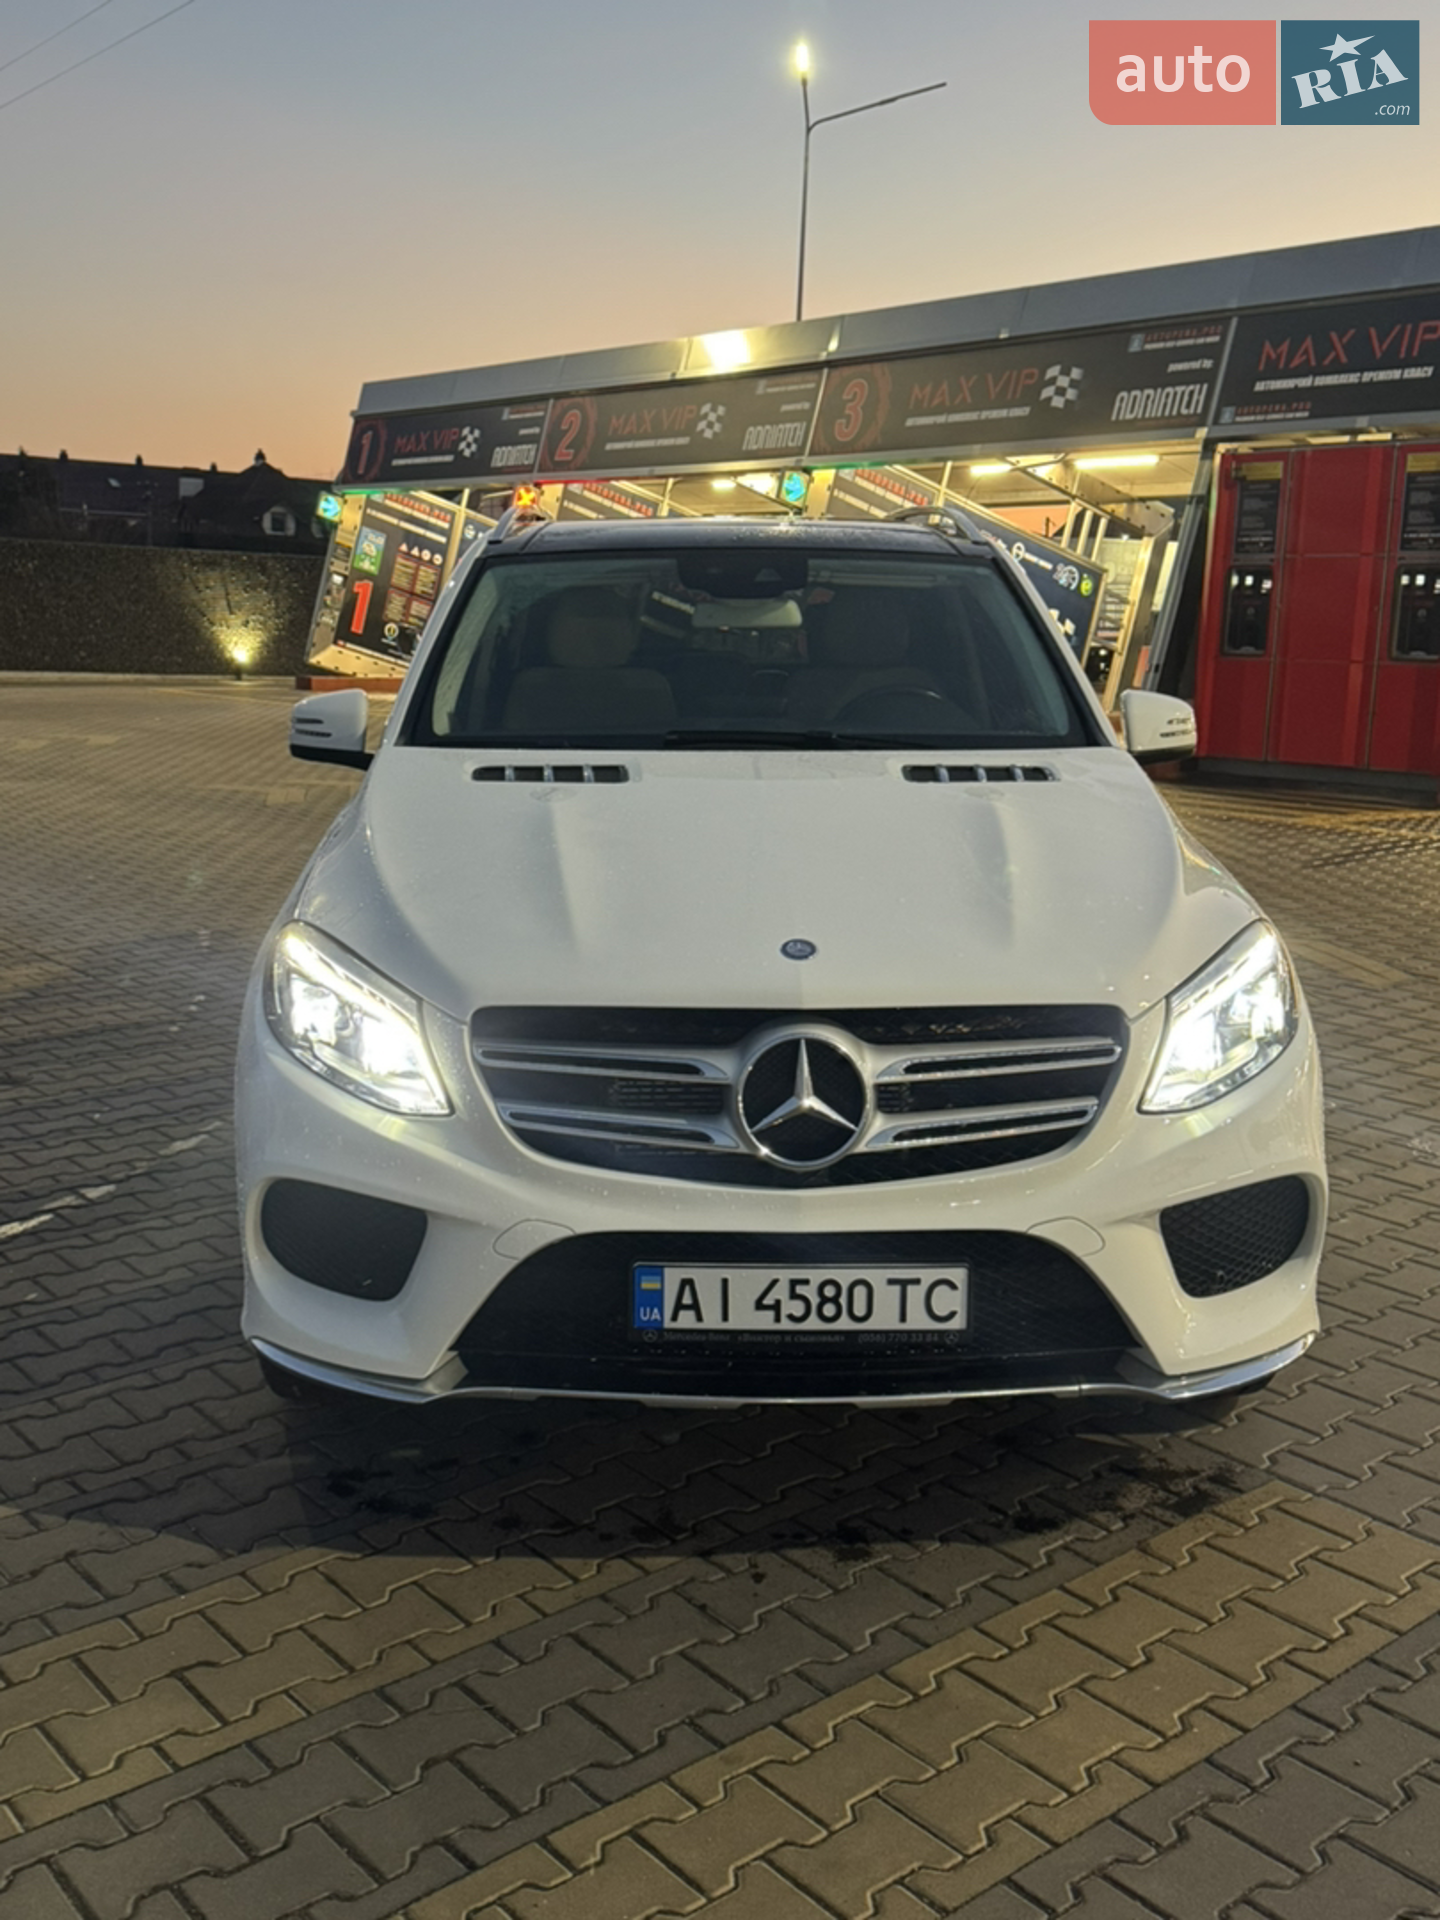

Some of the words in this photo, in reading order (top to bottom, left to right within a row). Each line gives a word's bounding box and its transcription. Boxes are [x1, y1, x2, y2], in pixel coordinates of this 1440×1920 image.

[1258, 328, 1356, 371] MAX
[1368, 320, 1440, 360] VIP
[834, 378, 868, 442] 3
[909, 374, 978, 409] MAX
[985, 367, 1039, 400] VIP
[394, 431, 433, 455] MAX
[432, 427, 460, 450] VIP
[554, 409, 582, 461] 2
[608, 408, 658, 436] MAX
[662, 405, 697, 431] VIP
[357, 430, 373, 475] 1
[350, 579, 374, 635] 1
[639, 1307, 662, 1322] UA
[670, 1277, 730, 1323] AI
[754, 1278, 874, 1324] 4580
[886, 1278, 960, 1323] TC
